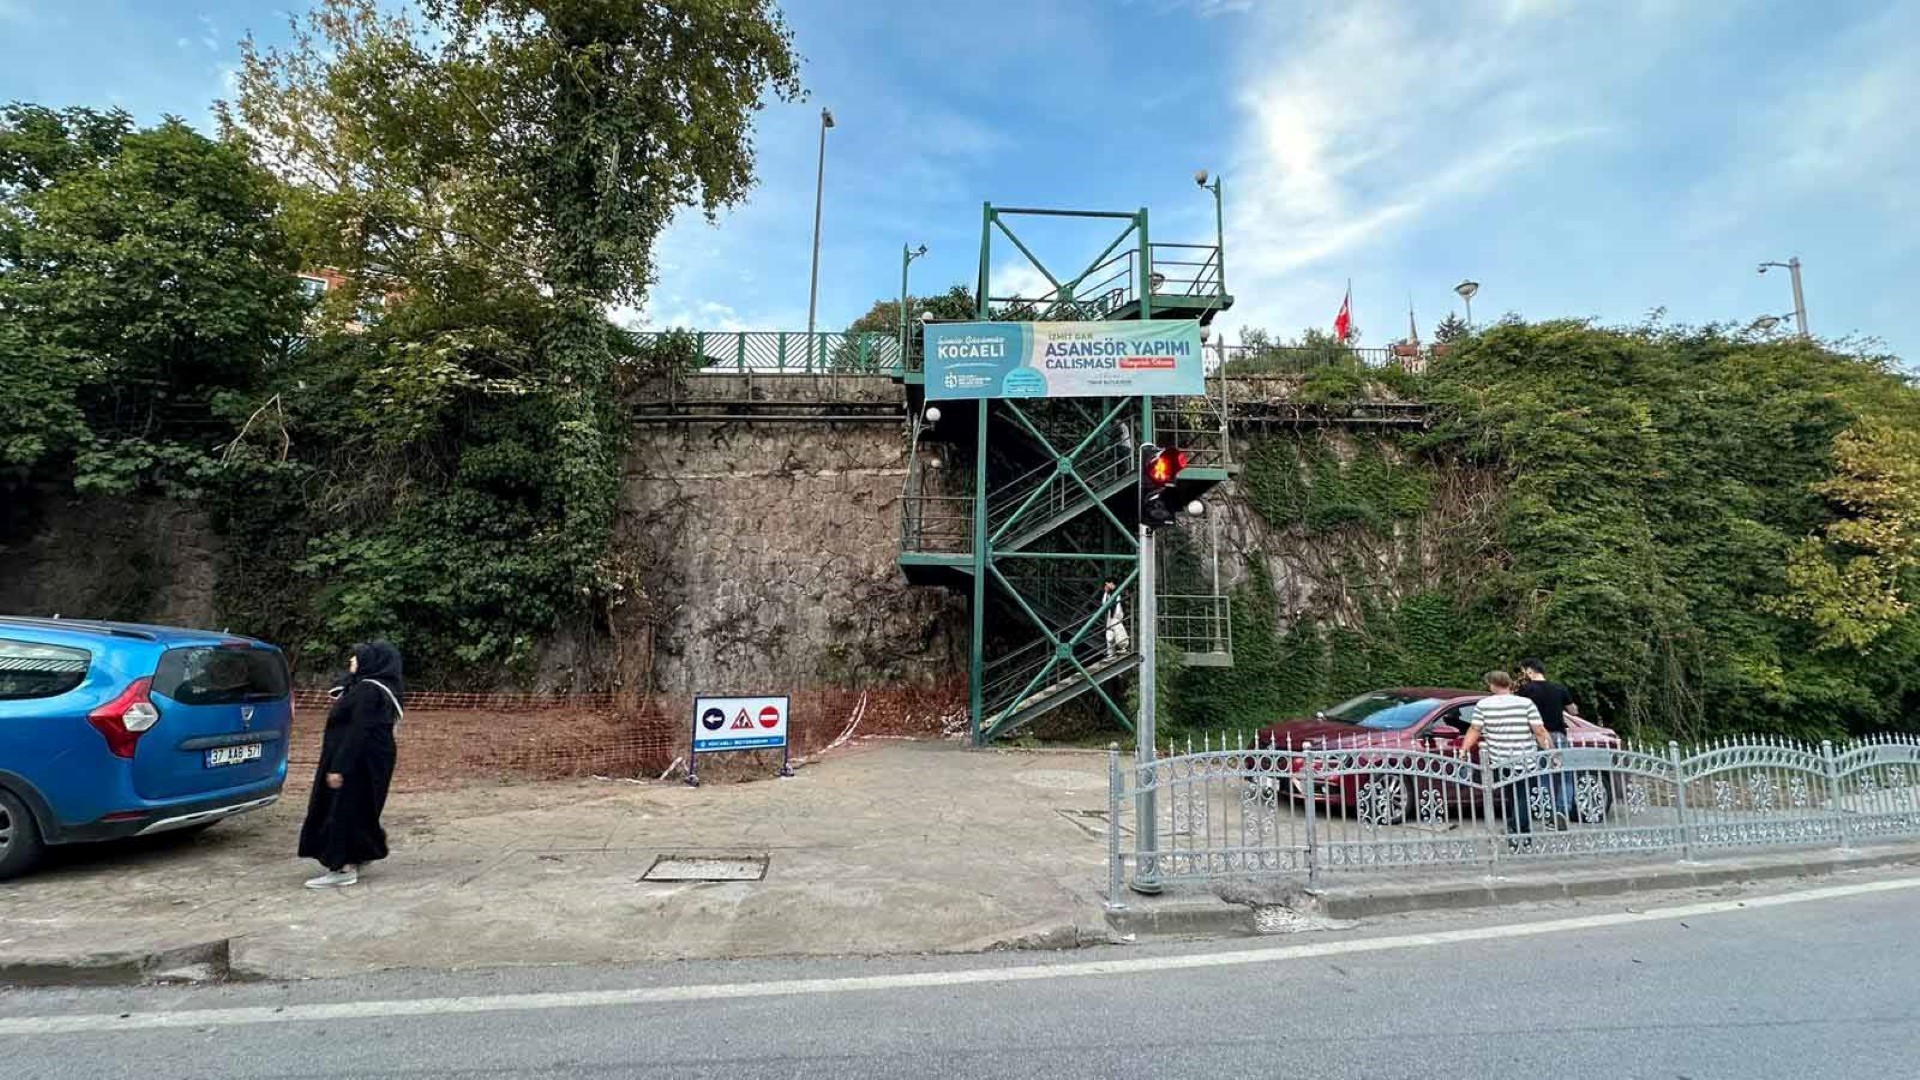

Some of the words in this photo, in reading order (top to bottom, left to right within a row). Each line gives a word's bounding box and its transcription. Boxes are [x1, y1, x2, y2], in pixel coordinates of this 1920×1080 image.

[1045, 338, 1127, 357] ASANSÖR
[1132, 340, 1190, 356] YAPIMI
[212, 749, 223, 762] 37
